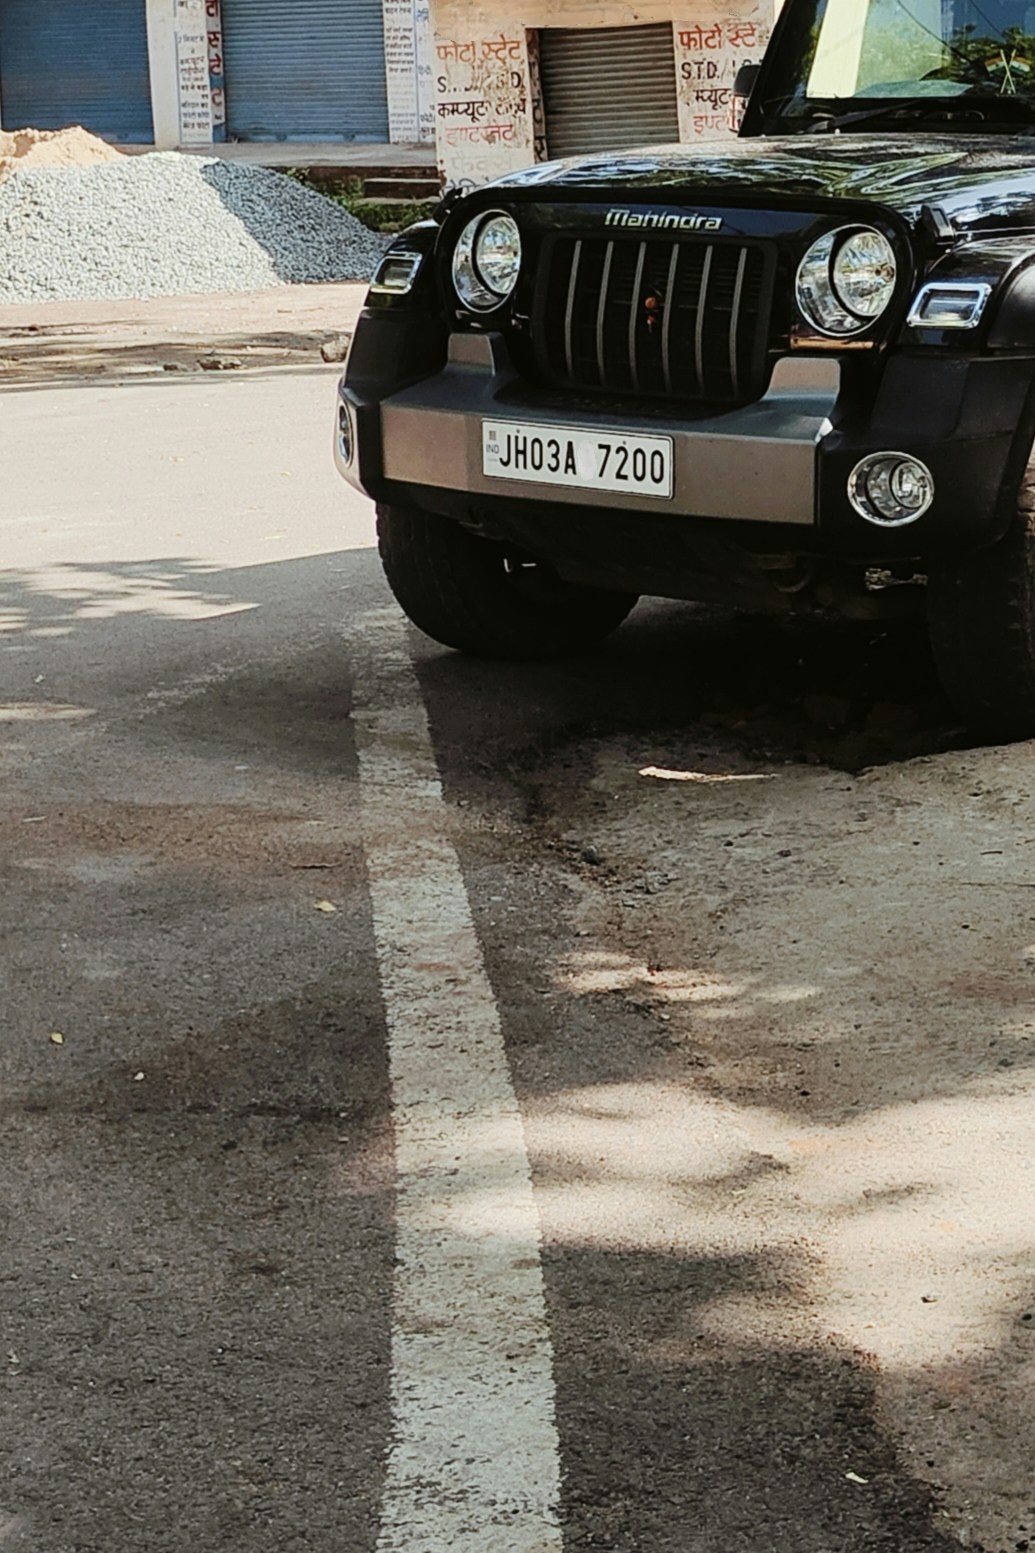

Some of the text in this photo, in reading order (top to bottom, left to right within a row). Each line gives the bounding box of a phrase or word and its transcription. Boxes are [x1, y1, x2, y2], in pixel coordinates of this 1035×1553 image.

[678, 22, 722, 50] फोटो
[438, 100, 491, 123] कम्प्यूट
[604, 208, 722, 230] Mahindra
[499, 433, 665, 484] JH03A 7200
